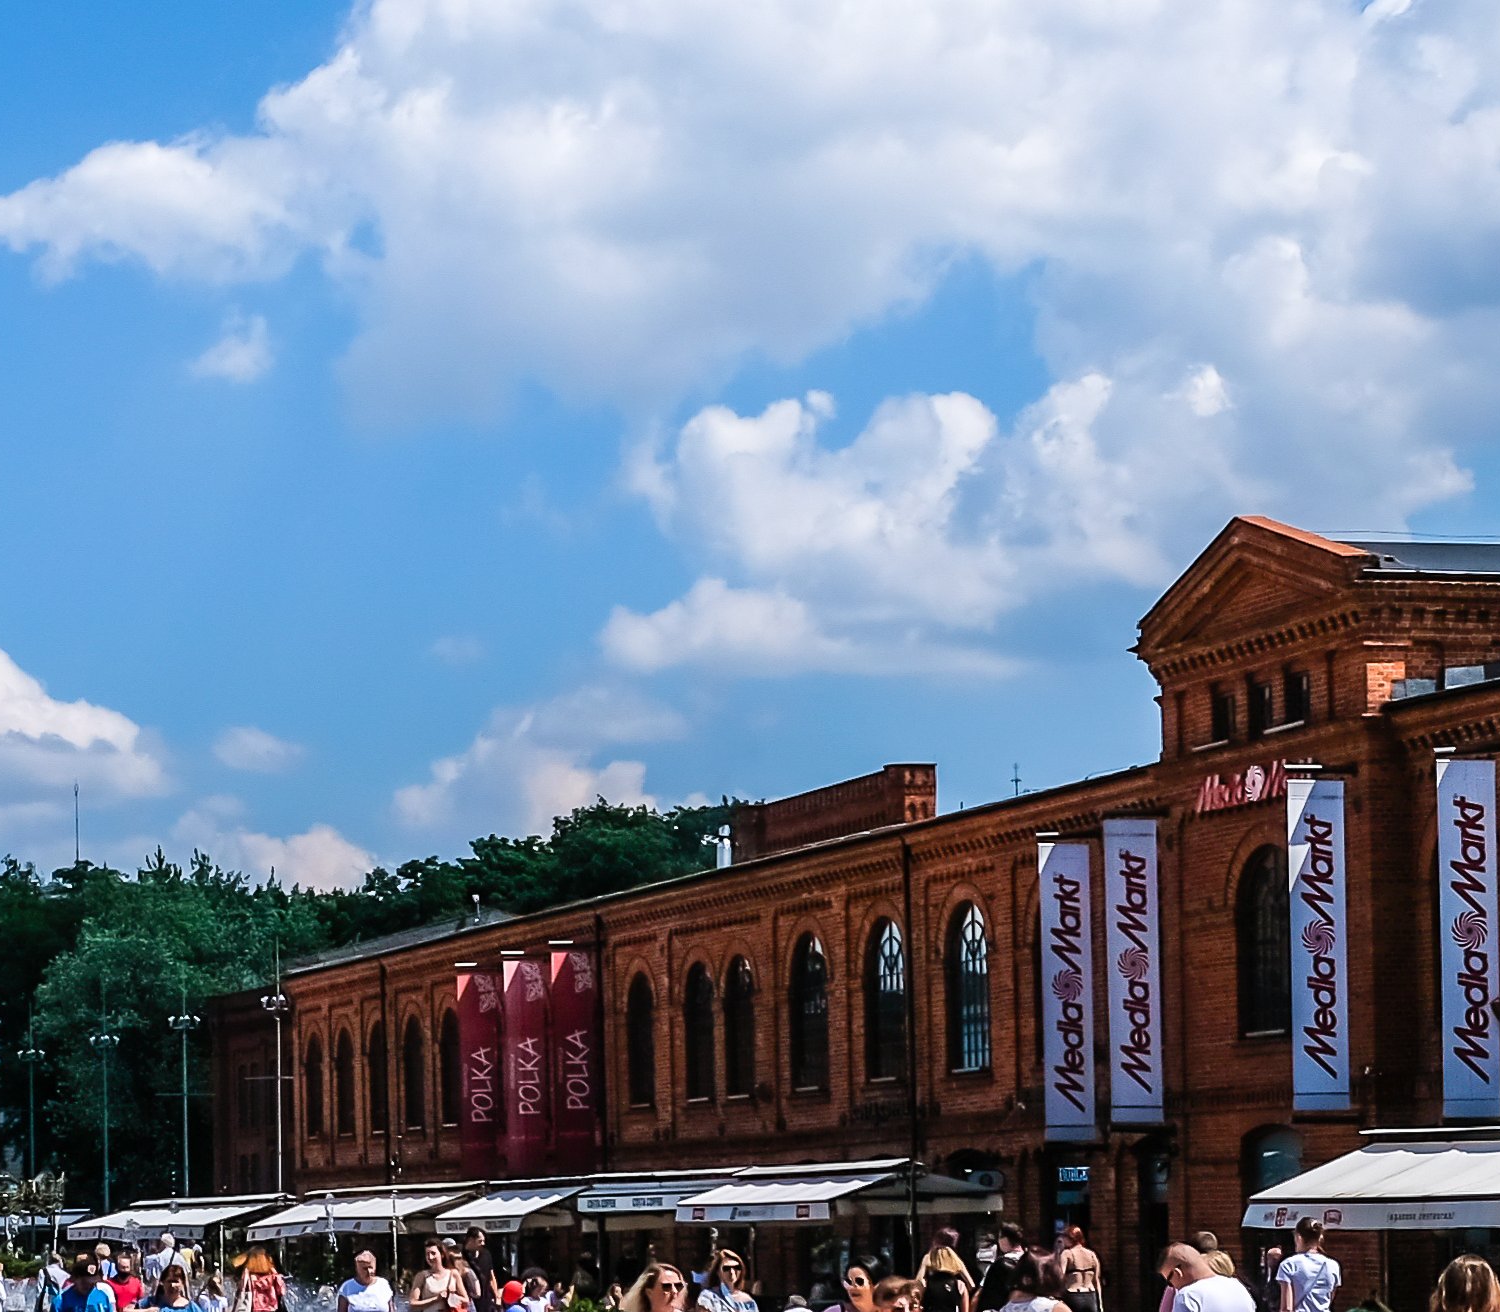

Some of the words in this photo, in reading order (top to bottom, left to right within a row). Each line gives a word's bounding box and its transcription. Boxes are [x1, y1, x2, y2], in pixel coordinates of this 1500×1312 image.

[1115, 849, 1149, 954] Markt
[1300, 813, 1335, 927] Markt
[1450, 795, 1487, 919] Markt
[1050, 872, 1083, 976] Markt
[565, 1029, 591, 1109] POLKA
[1053, 1000, 1086, 1113] Media
[1119, 979, 1152, 1094] Media
[1303, 954, 1338, 1080] Media
[1453, 949, 1490, 1085] Media
[471, 1046, 493, 1122] POLKA
[517, 1037, 543, 1115] POLKA
